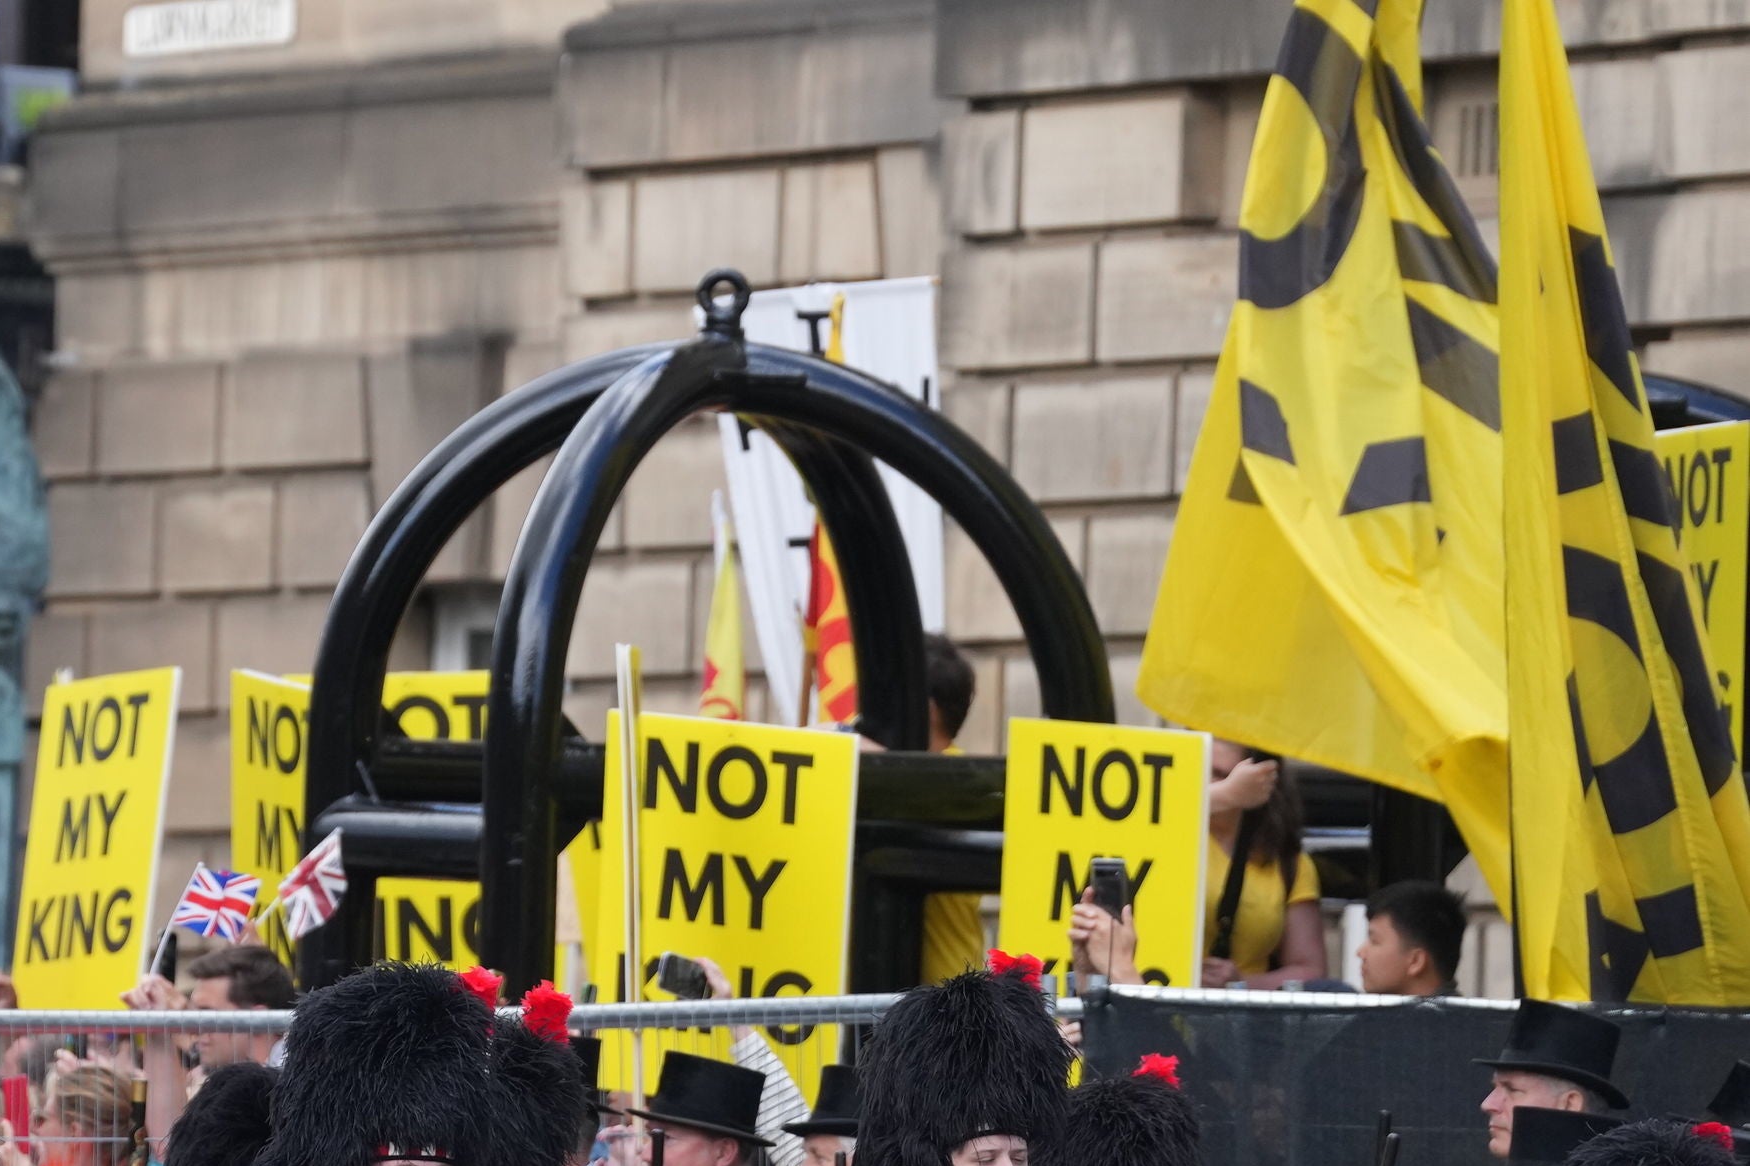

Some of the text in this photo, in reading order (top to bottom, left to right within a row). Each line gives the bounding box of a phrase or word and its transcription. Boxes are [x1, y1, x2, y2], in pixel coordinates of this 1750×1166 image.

[57, 693, 150, 769] NOT
[246, 695, 308, 775] NO
[392, 695, 490, 741] OT
[643, 738, 815, 825] NOT
[1039, 744, 1174, 825] NOT
[55, 791, 128, 864] MY
[25, 888, 134, 965] KING
[657, 848, 787, 931] MY
